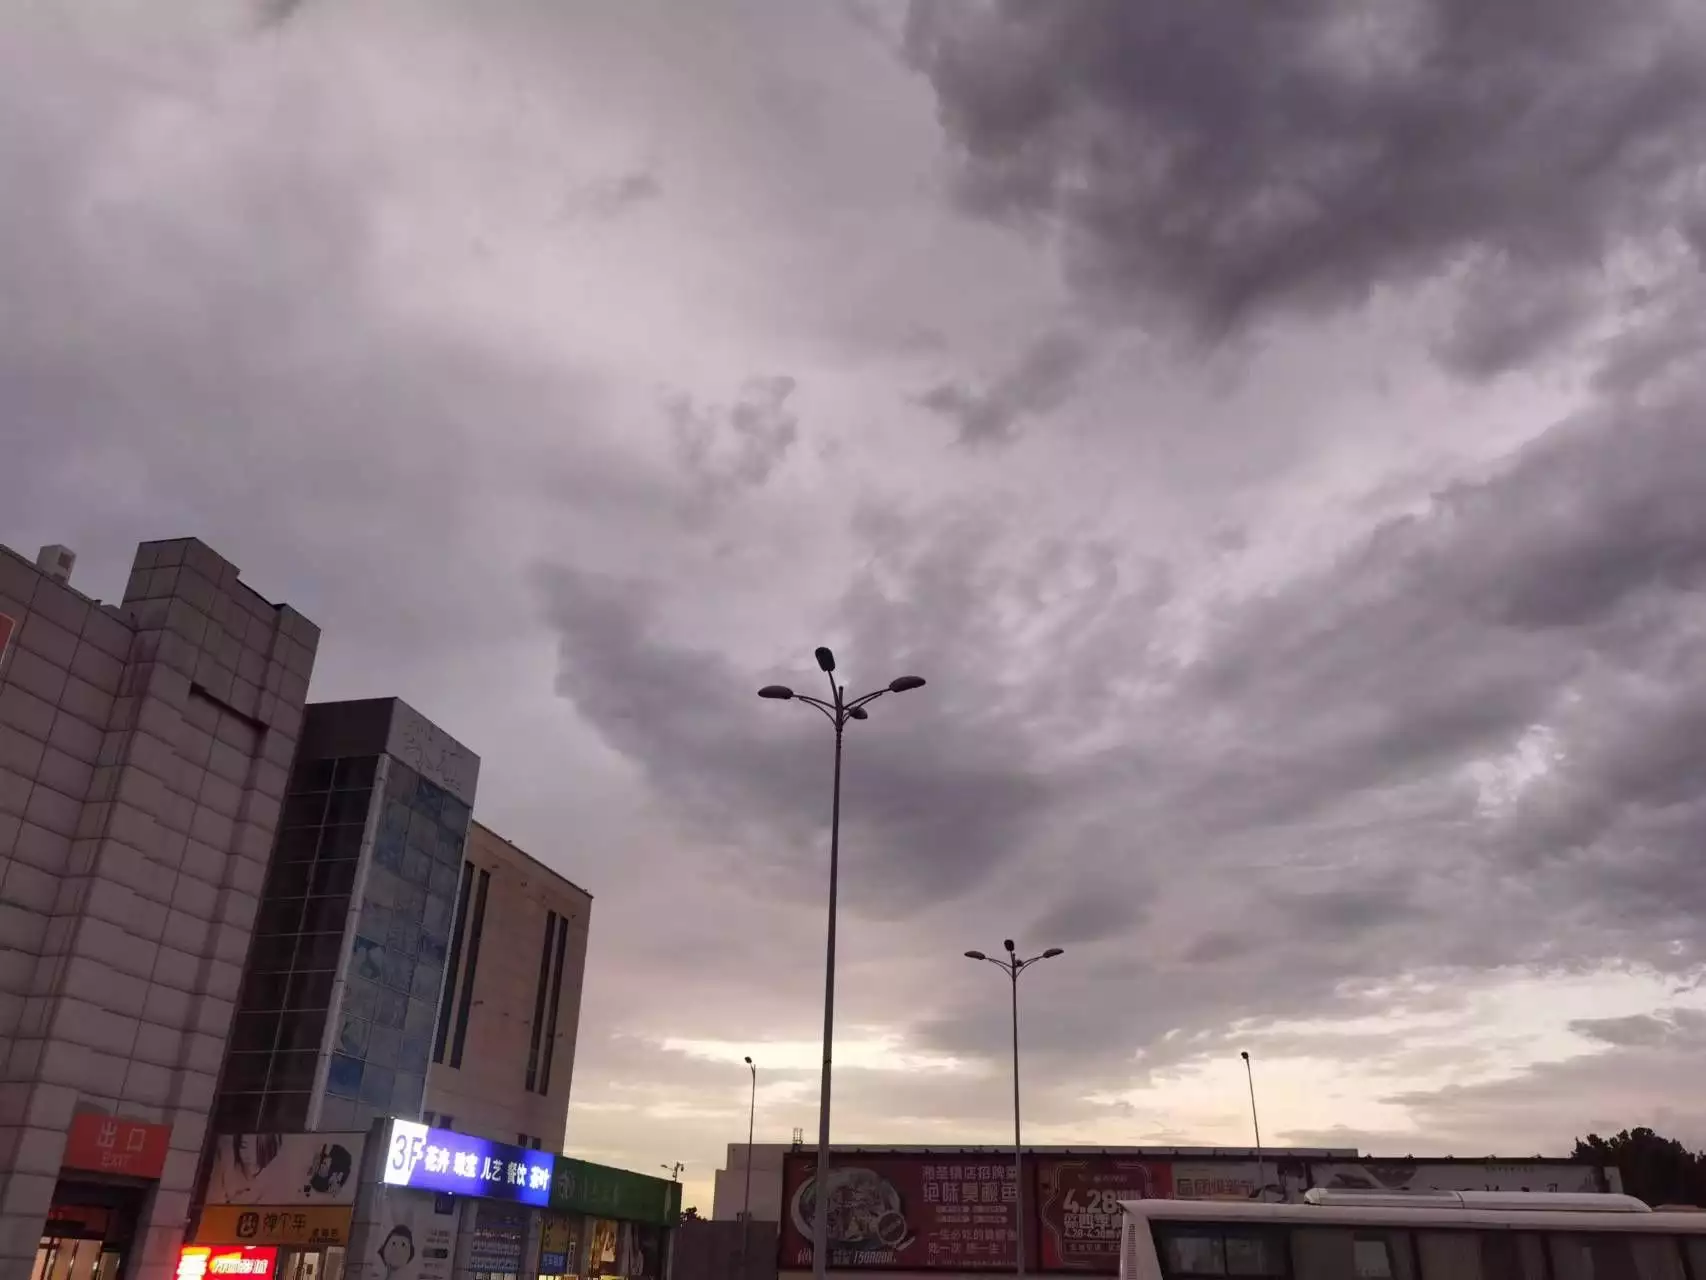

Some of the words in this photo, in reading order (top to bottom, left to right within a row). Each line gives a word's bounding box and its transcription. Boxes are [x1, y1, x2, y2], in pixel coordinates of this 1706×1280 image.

[96, 1120, 146, 1152] 出口
[391, 1134, 426, 1173] 3F
[507, 1162, 527, 1186] 餐饮
[1062, 1188, 1117, 1214] 4.28
